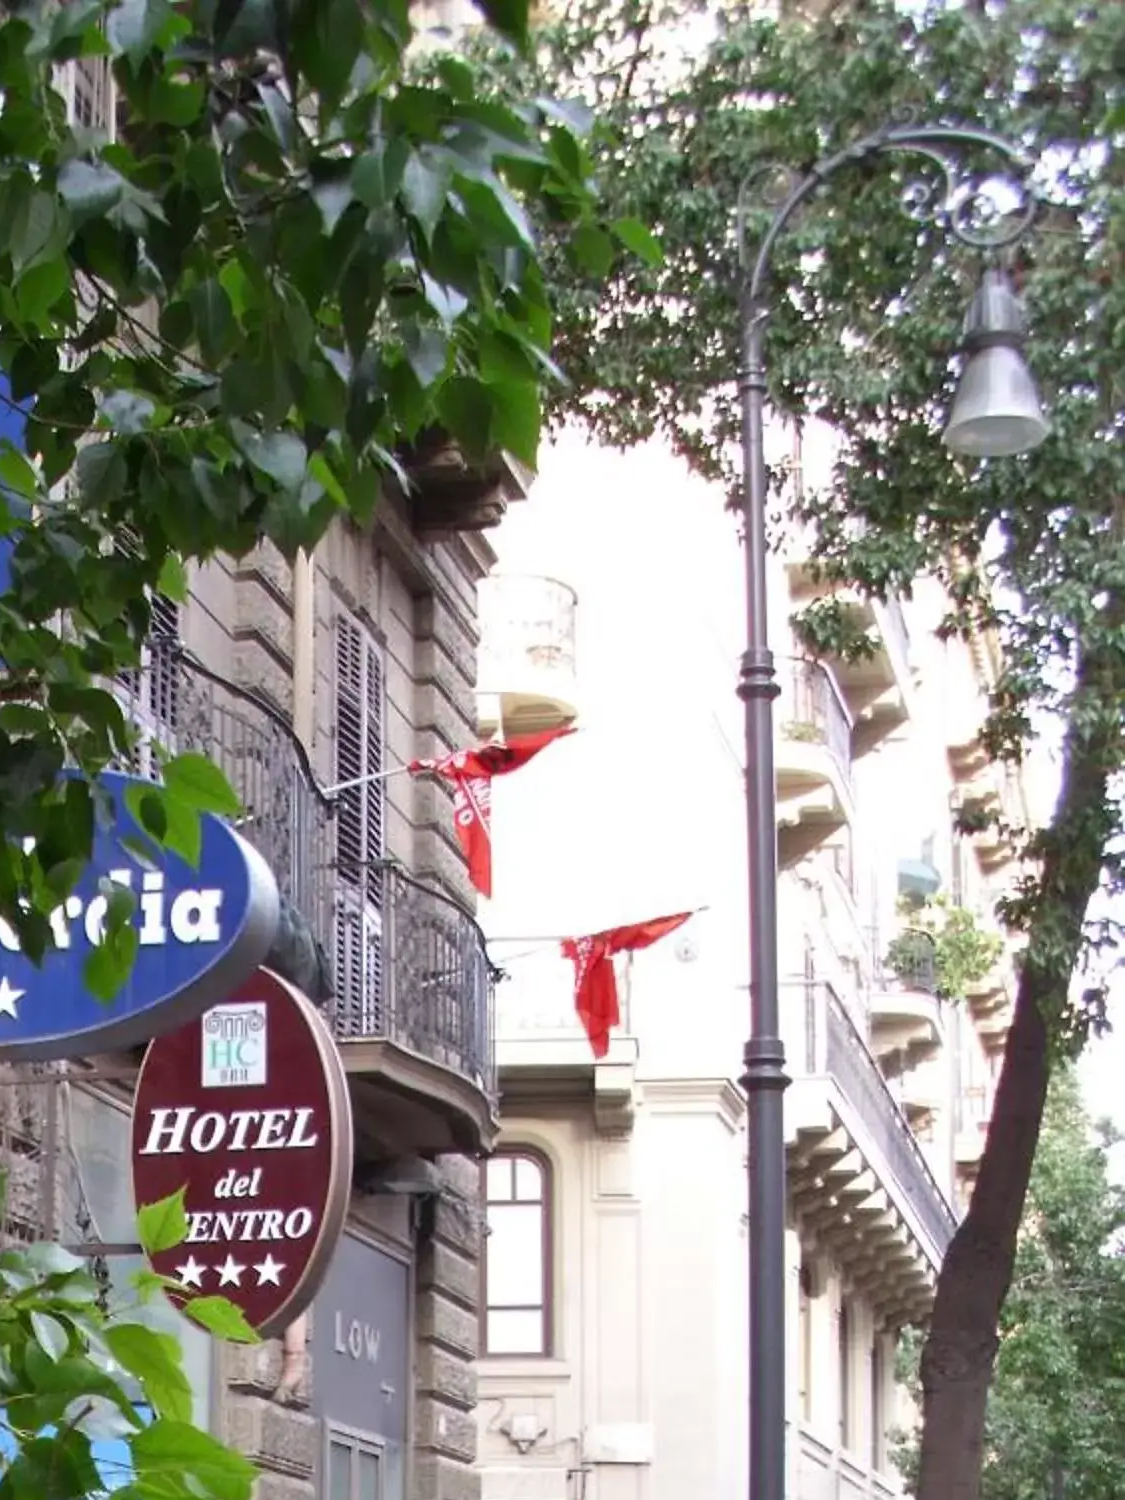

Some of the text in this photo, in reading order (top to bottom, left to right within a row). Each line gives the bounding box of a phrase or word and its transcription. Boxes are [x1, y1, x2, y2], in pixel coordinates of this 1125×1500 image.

[208, 1039, 258, 1067] HC
[139, 1107, 318, 1154] HOTEL
[214, 1168, 262, 1198] del
[183, 1208, 312, 1243] ENTRO
